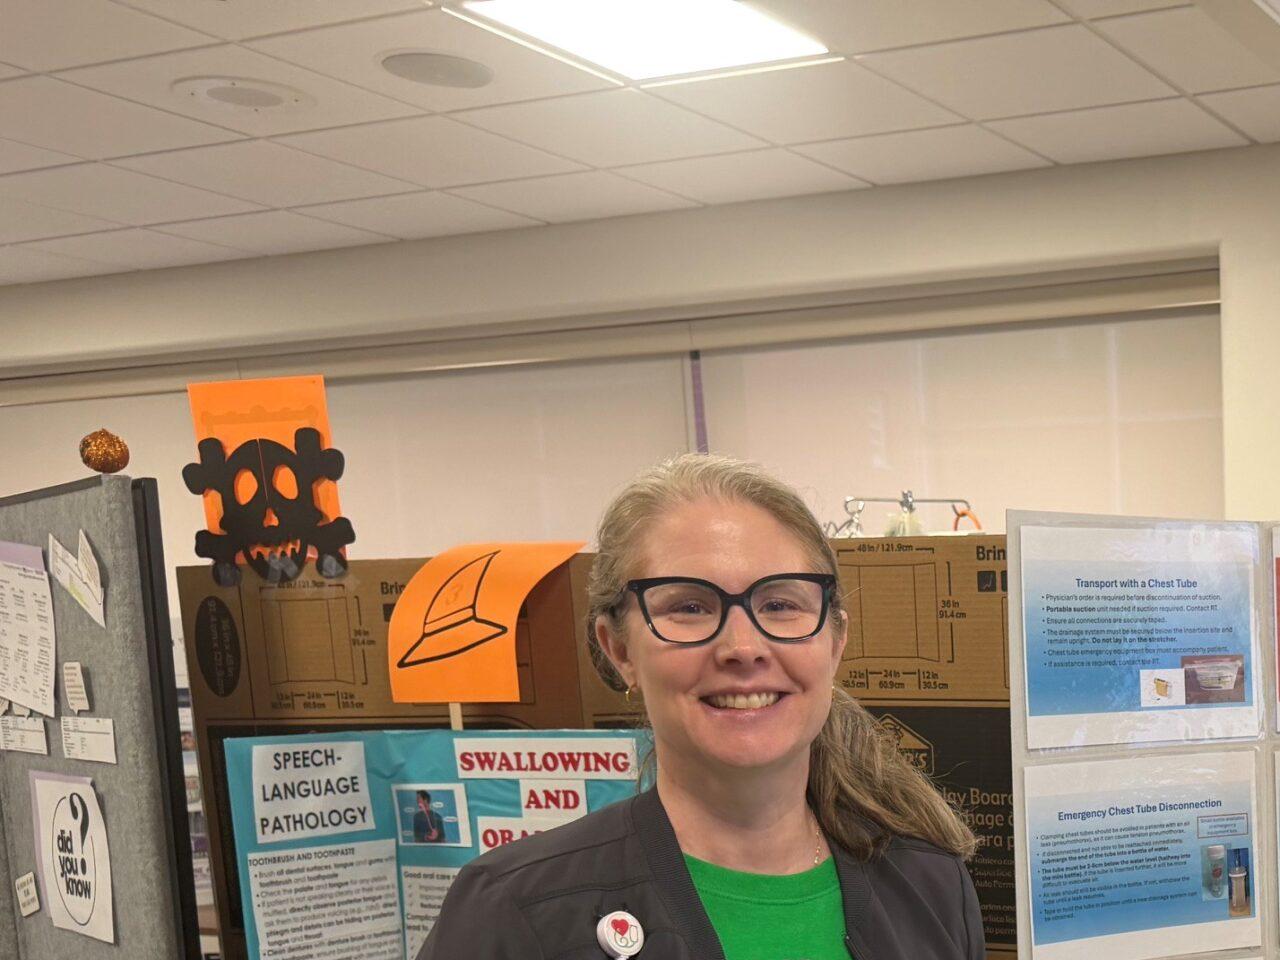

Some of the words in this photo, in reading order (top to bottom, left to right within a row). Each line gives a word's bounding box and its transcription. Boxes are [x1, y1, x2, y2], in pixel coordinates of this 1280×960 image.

[1076, 578, 1118, 589] Transport
[1119, 578, 1139, 588] with
[1148, 578, 1174, 588] Chest
[1177, 578, 1197, 588] Tube
[273, 749, 342, 770] SPEECH-
[460, 751, 630, 773] SWALLOWING
[262, 776, 360, 802] LANGUAGE
[524, 789, 580, 809] AND
[260, 806, 367, 835] PATHOLOGY
[1058, 809, 1106, 821] Emergency
[1109, 806, 1134, 816] Chest
[1136, 804, 1157, 813] Tube
[1158, 799, 1222, 812] Disconnection
[57, 829, 73, 854] did
[482, 829, 544, 849] OR
[58, 855, 78, 877] you
[249, 855, 295, 866] TOOTHBRUSH
[297, 853, 313, 861] AND
[314, 848, 355, 859] TOOTHPASTE
[65, 871, 91, 899] know
